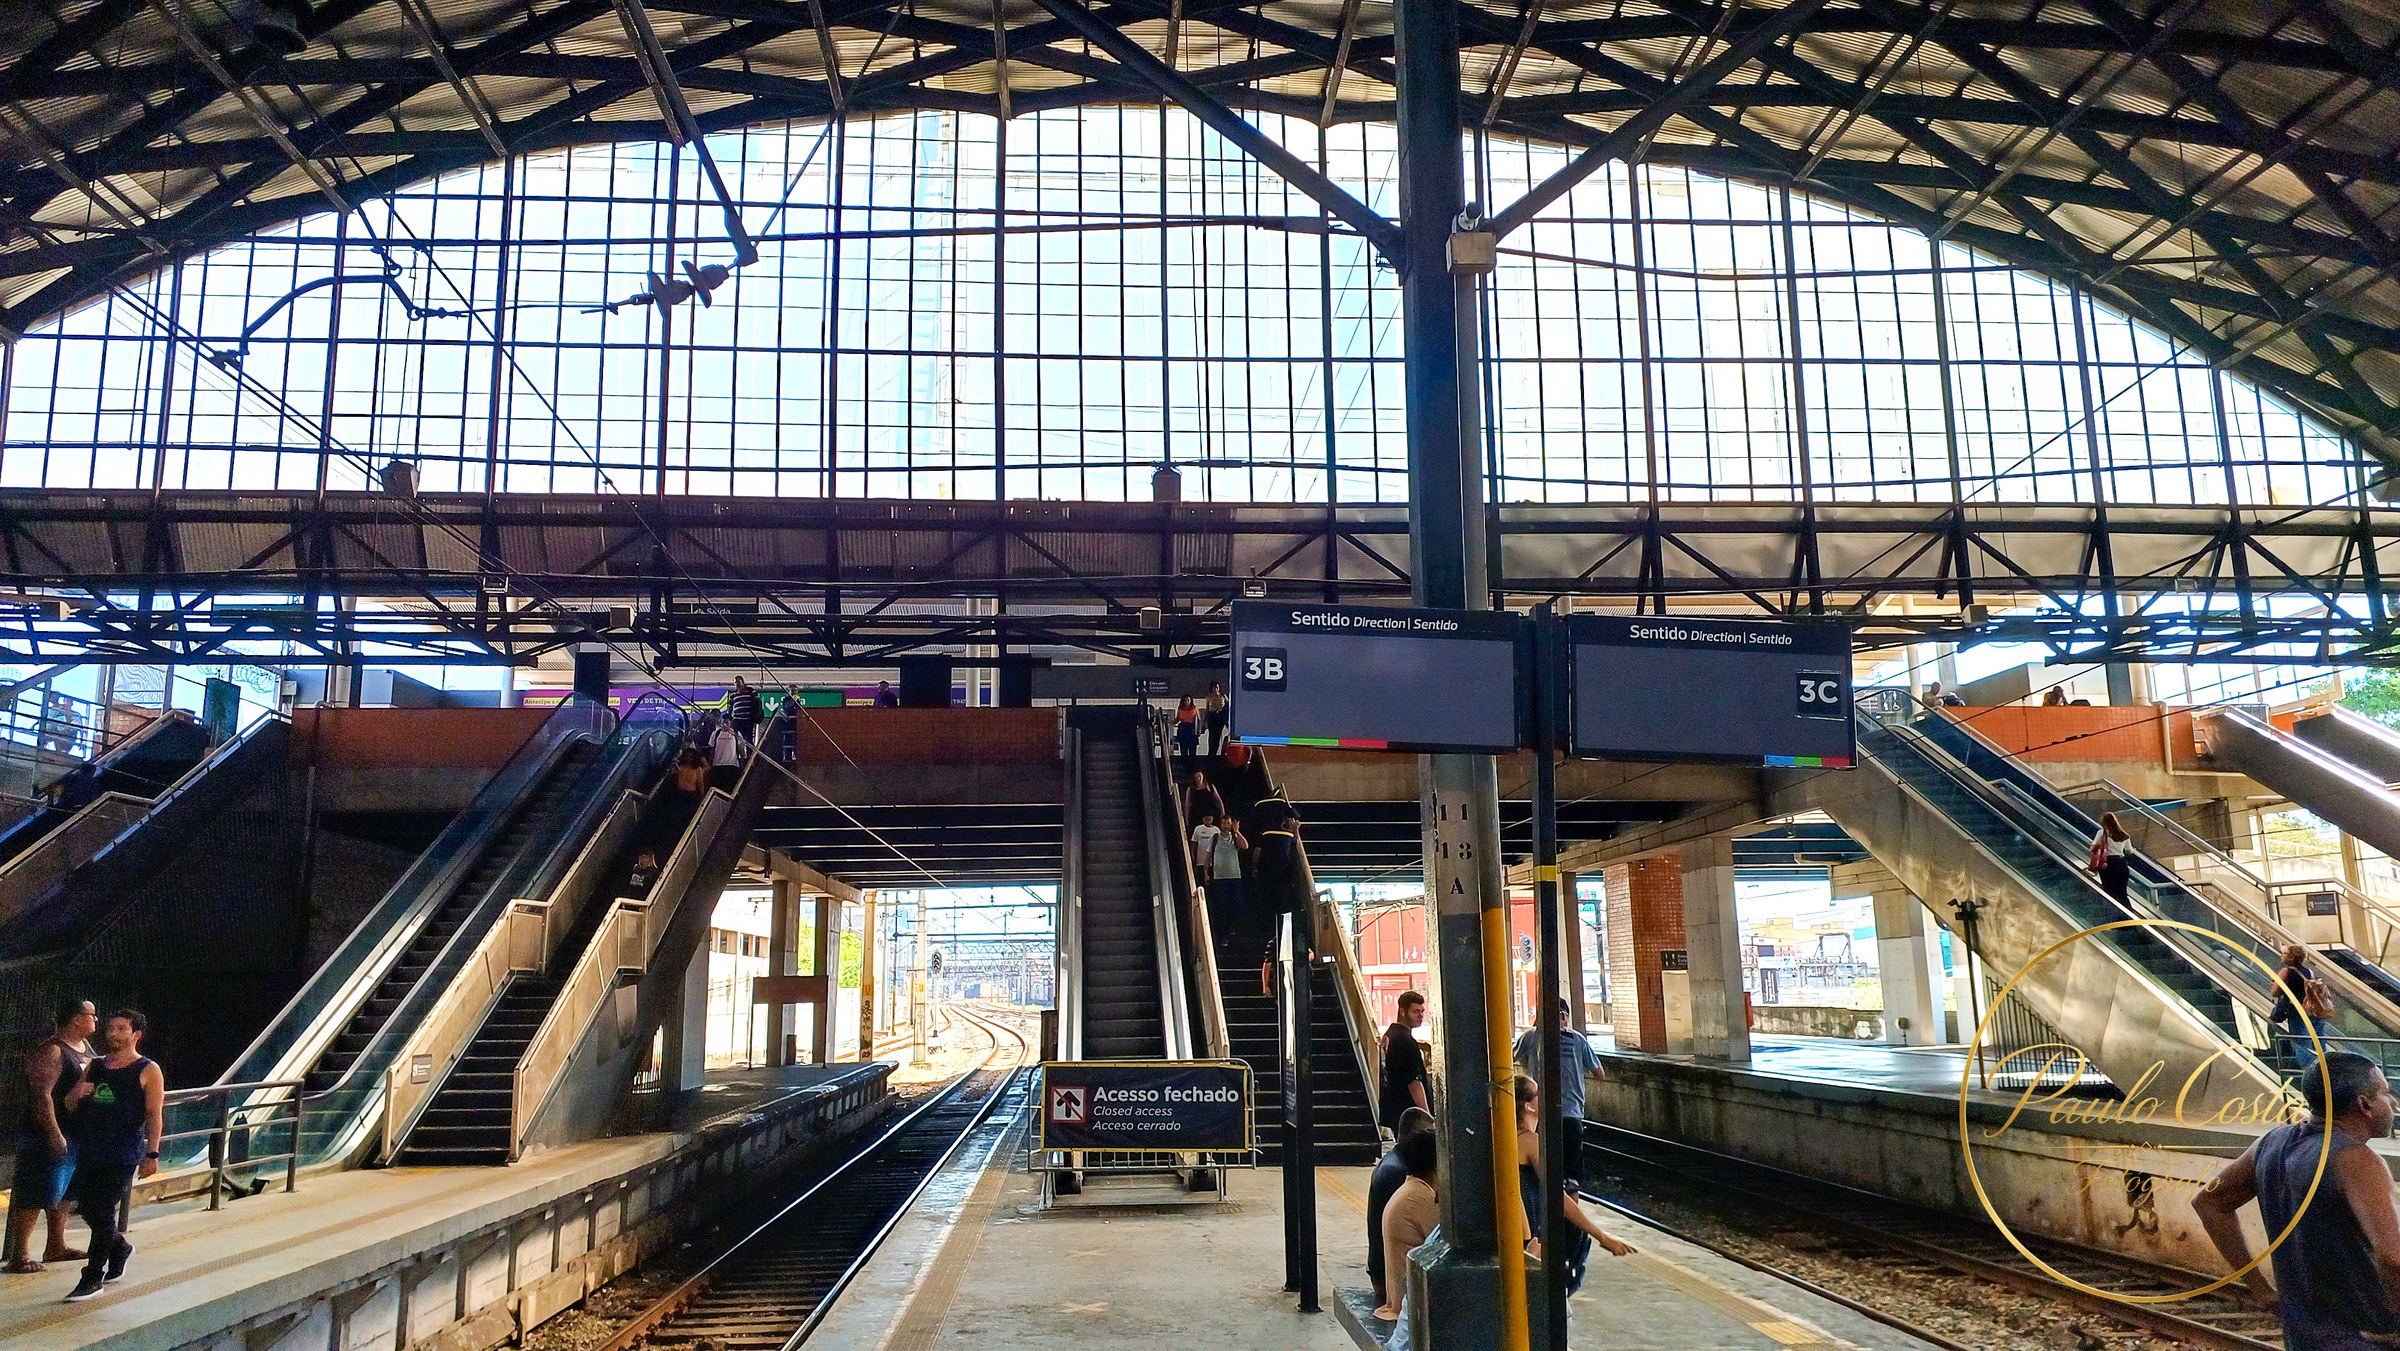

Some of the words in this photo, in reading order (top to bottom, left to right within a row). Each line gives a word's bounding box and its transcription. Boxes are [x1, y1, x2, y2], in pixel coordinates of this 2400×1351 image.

[1291, 611, 1350, 627] Sentido
[1353, 616, 1406, 629] Direction
[1413, 619, 1459, 631] Sentido
[1630, 624, 1687, 641] Sentido
[1690, 630, 1742, 643] Direction
[1748, 632, 1793, 646] Sentido
[1245, 657, 1284, 682] 3B
[1799, 679, 1839, 704] 3C
[1450, 877, 1464, 894] A
[1093, 1086, 1159, 1102] Acesso
[1164, 1085, 1239, 1103] fechado
[1093, 1105, 1132, 1116] Closed
[1134, 1108, 1173, 1116] access
[1092, 1120, 1134, 1131] Acceso
[1137, 1120, 1181, 1131] cerrado
